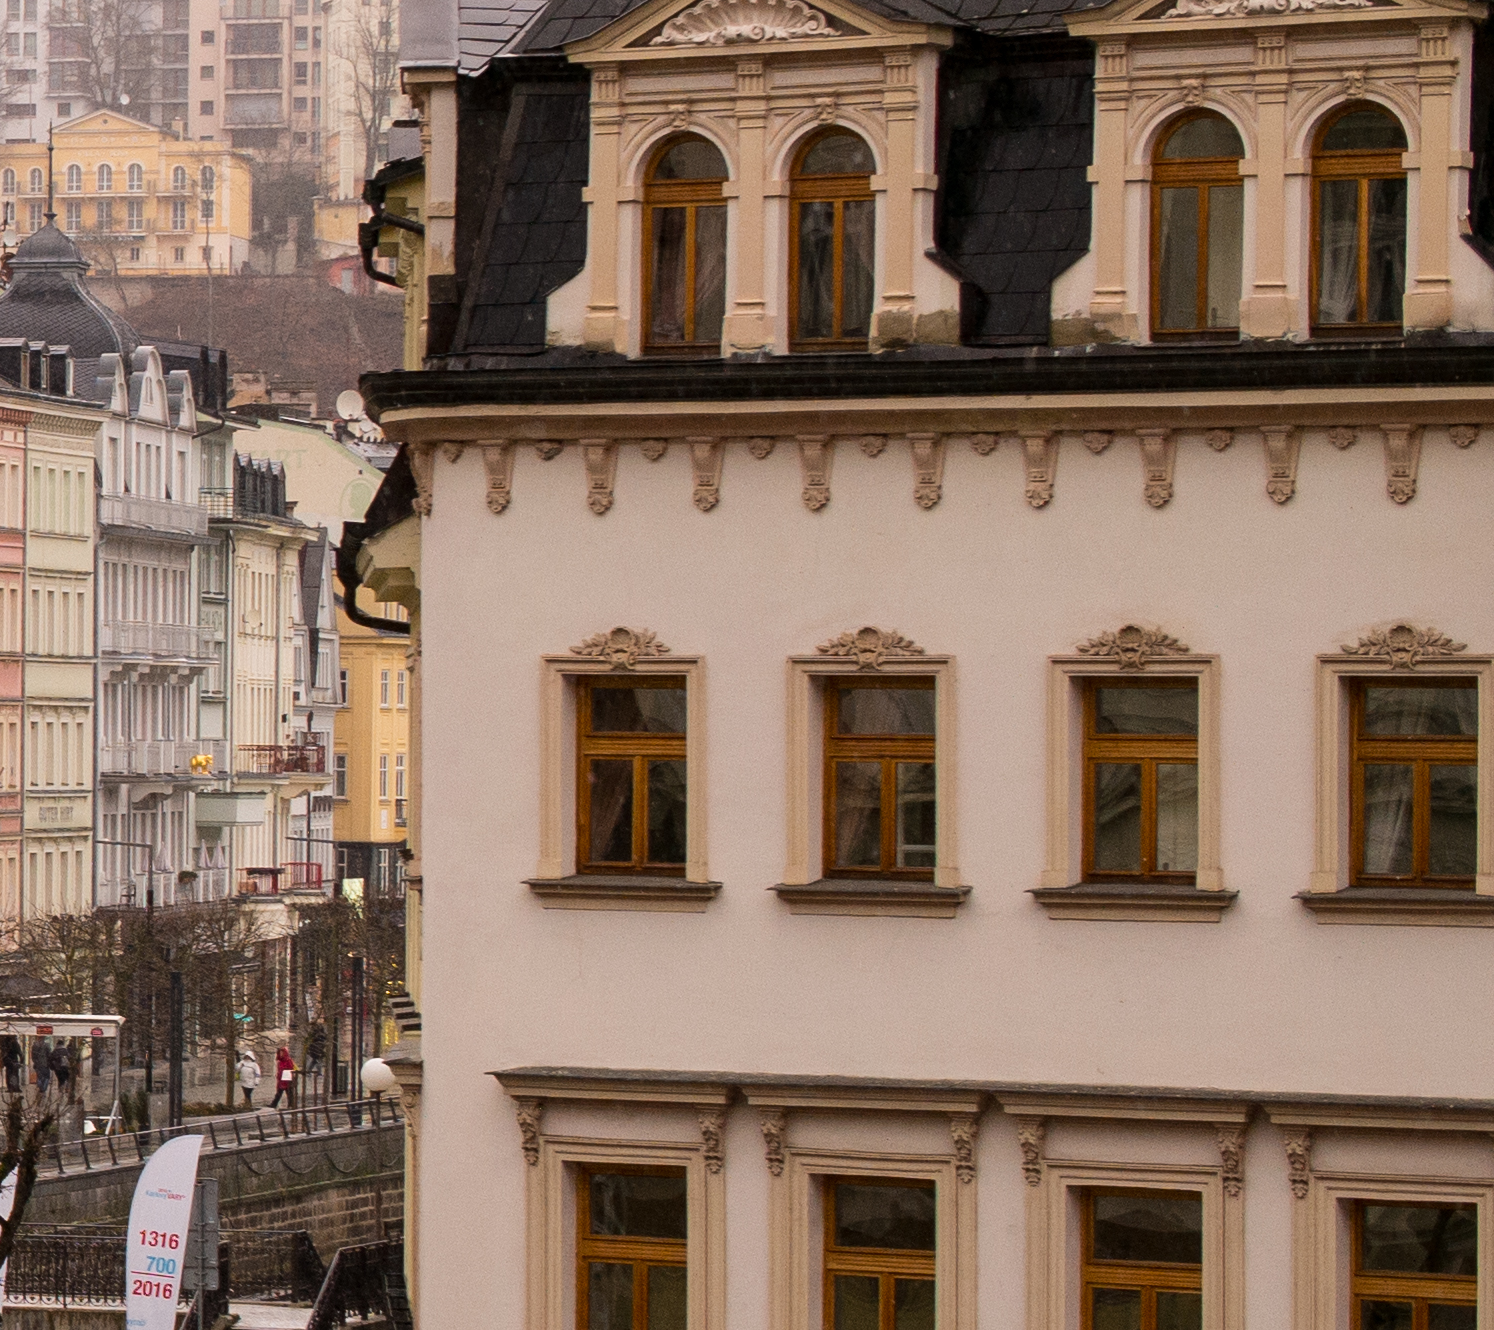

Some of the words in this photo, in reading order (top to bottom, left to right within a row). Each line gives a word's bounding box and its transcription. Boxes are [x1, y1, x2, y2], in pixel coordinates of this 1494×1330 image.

[139, 1229, 180, 1249] 1316
[146, 1255, 177, 1274] 700
[132, 1279, 173, 1299] 2016
